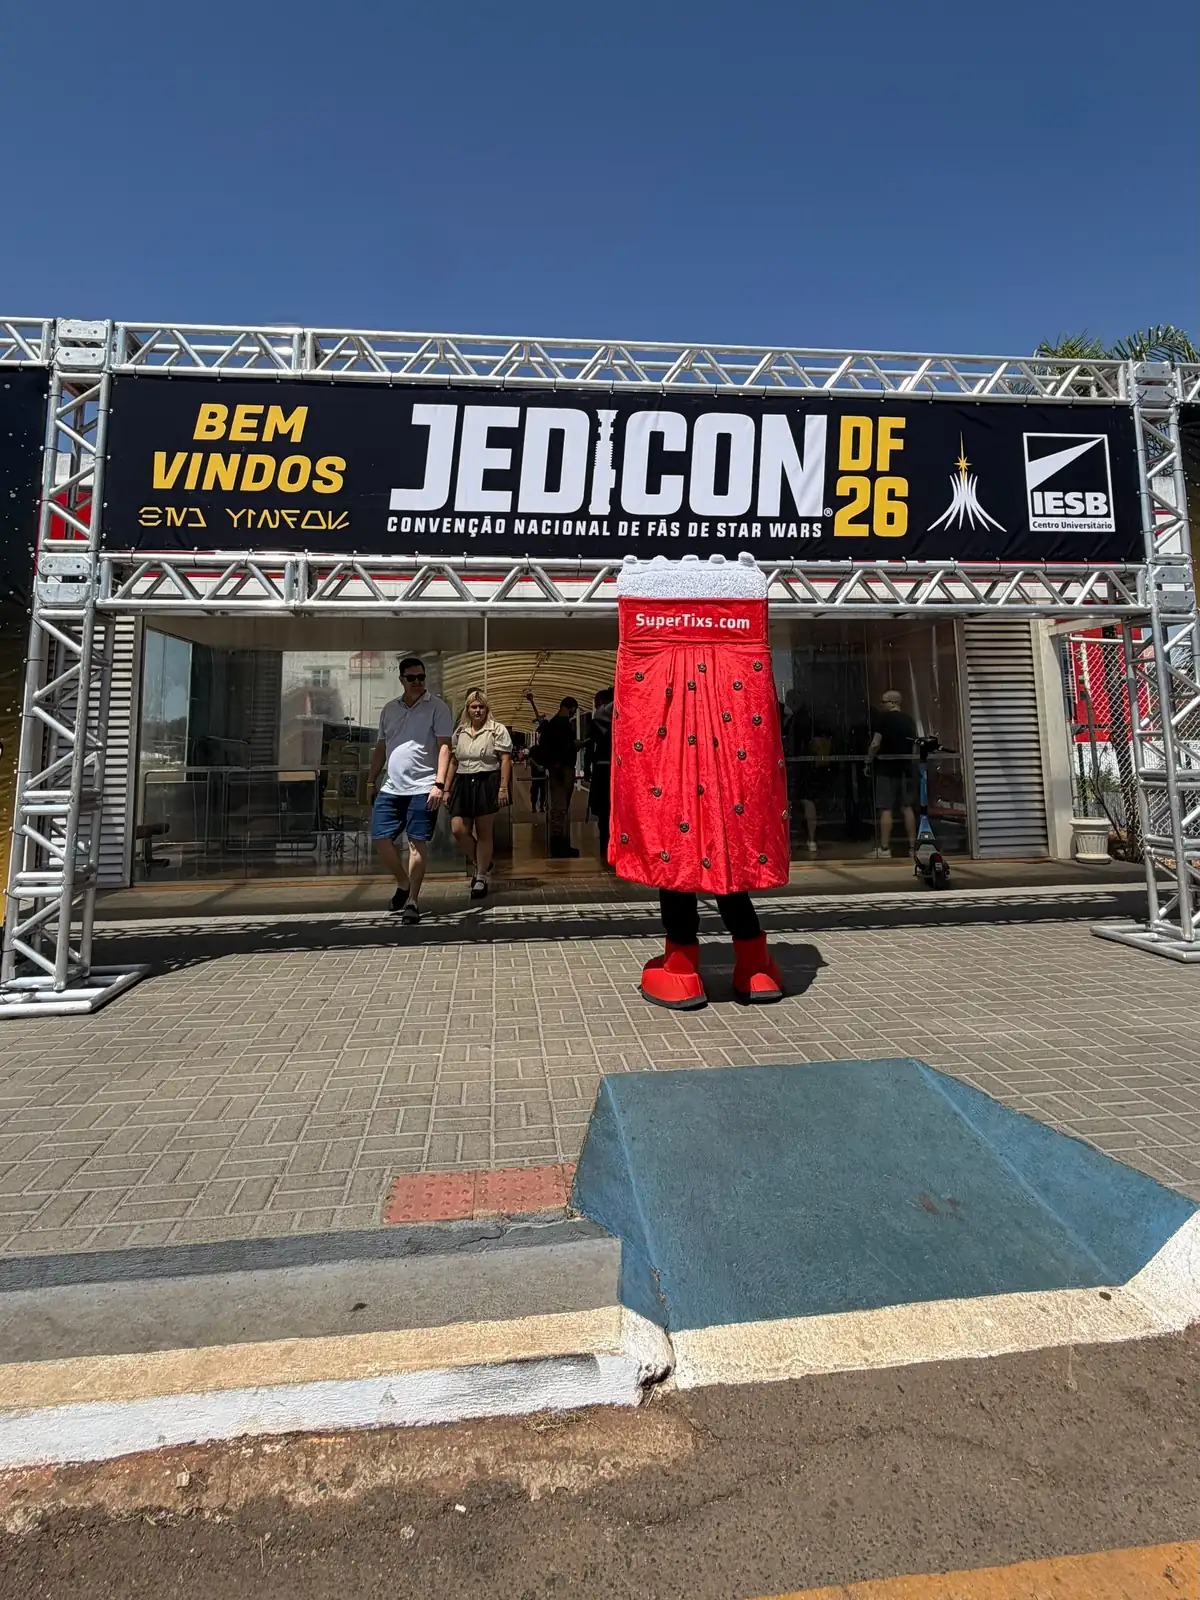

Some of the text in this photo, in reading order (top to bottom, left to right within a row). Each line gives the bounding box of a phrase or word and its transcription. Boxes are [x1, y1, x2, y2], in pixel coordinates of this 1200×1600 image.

[193, 403, 308, 442] BEM
[839, 415, 905, 471] DF
[152, 452, 346, 494] VINDOS
[834, 476, 908, 537] 26
[1033, 491, 1108, 515] IESB
[386, 516, 822, 538] CONVENÇÃO NACIONAL DE FÃS DE STAR WARS
[1032, 521, 1113, 530] Centro Universitário
[635, 613, 750, 629] SuperTixs.com
